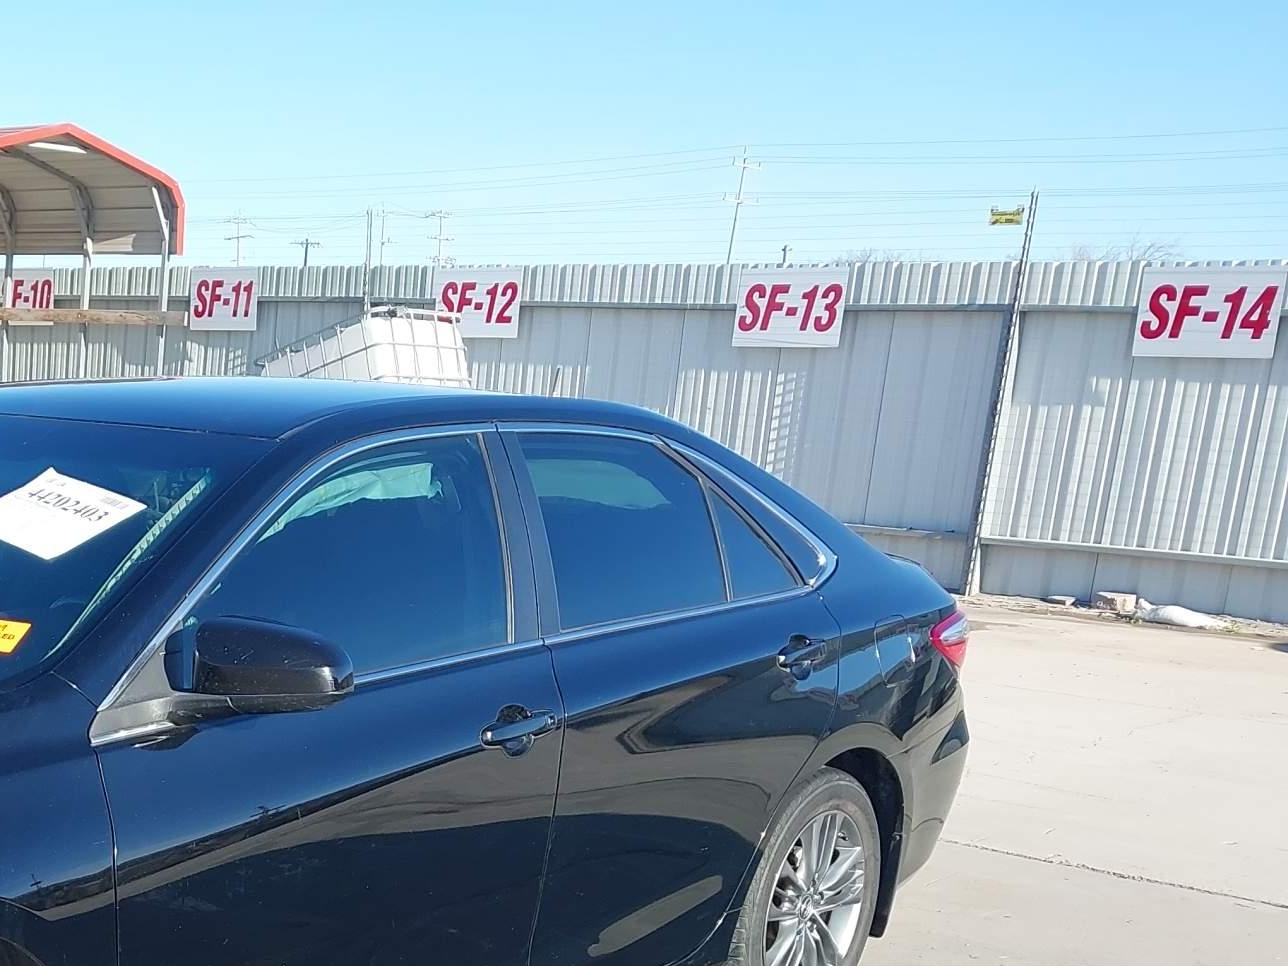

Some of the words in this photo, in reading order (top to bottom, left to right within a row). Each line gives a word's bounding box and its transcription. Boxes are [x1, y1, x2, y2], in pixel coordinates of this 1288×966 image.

[193, 279, 255, 319] SF-11
[437, 281, 519, 324] SF-12
[738, 283, 844, 332] SF-13
[1140, 283, 1280, 340] SF-14
[28, 488, 110, 522] 44202403
